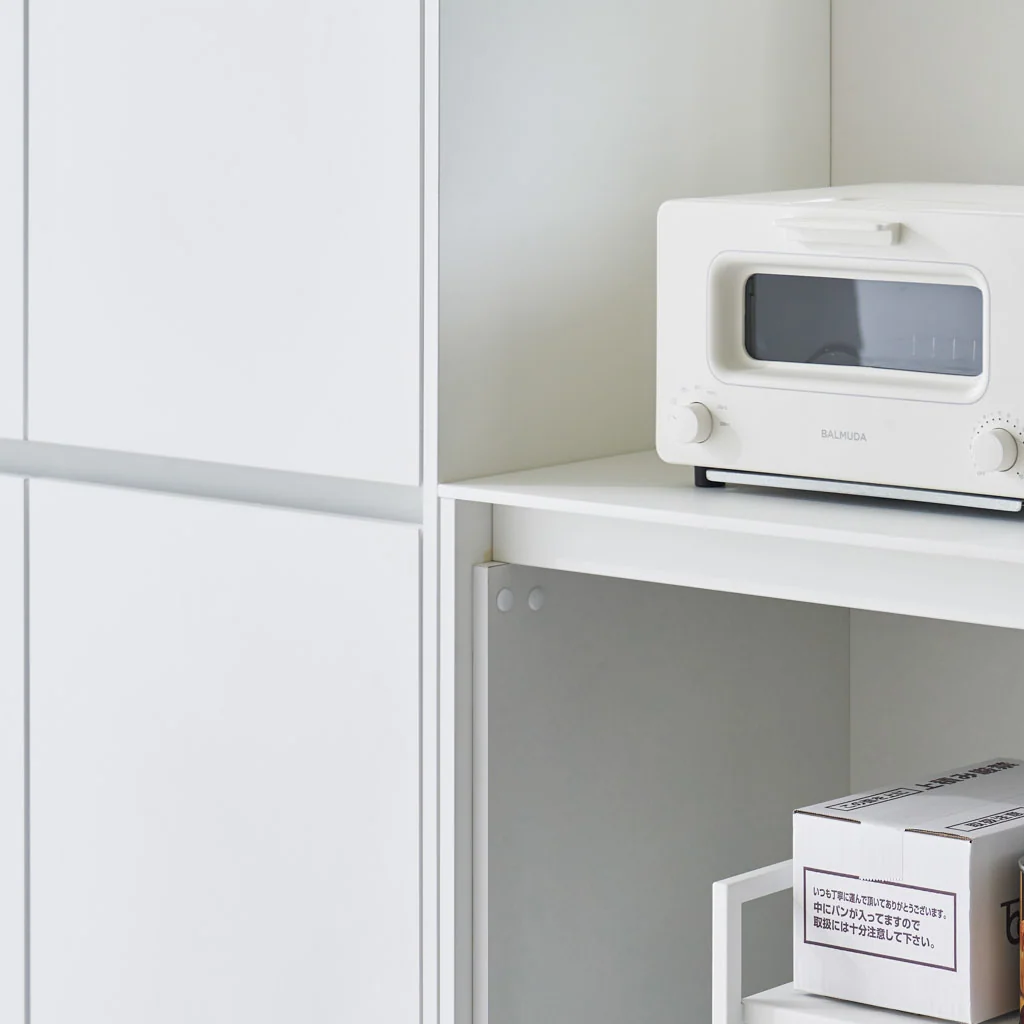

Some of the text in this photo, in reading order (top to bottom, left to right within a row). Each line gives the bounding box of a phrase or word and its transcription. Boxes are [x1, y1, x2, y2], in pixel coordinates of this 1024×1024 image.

[821, 429, 867, 442] BALMUDA
[813, 915, 935, 949] 取扱には十分注意して下さい。
